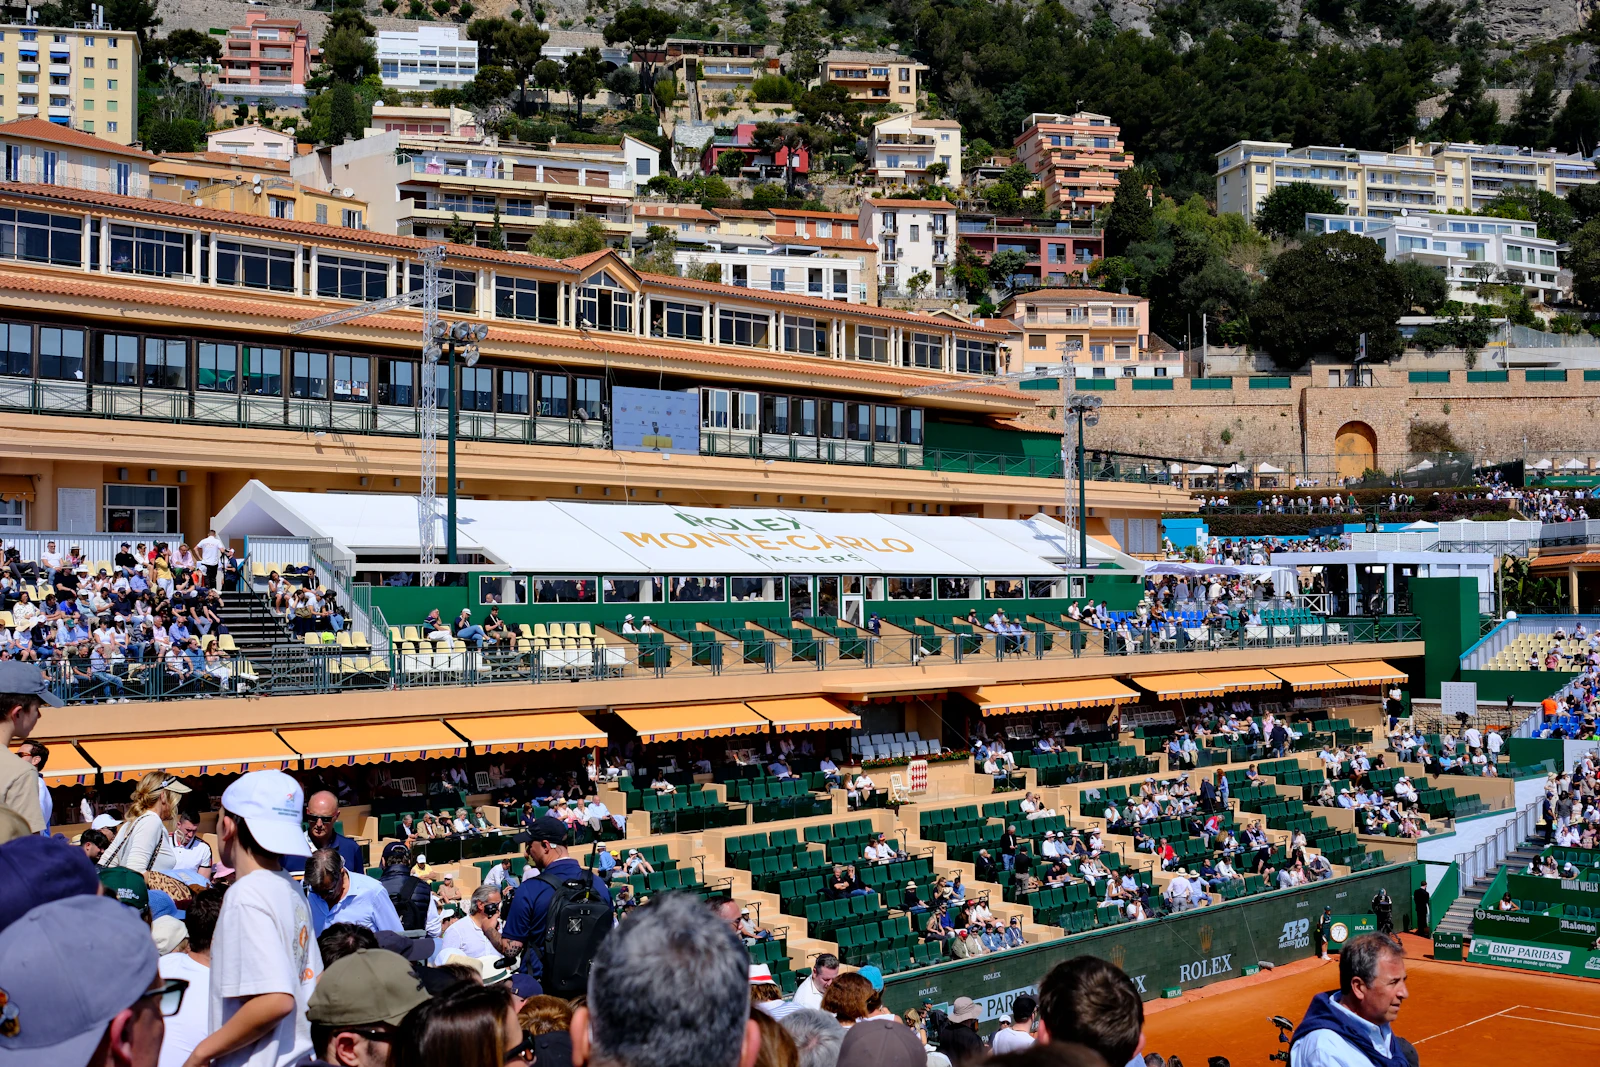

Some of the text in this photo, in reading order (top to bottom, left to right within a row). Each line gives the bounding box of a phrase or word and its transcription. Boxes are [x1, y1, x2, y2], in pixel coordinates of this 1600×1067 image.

[674, 512, 814, 532] ROLEX
[620, 531, 915, 553] MONTE-CARLO
[747, 553, 863, 564] MASTERS
[1561, 879, 1599, 893] INDIAN WELLS
[1335, 891, 1348, 899] ROLEX
[1296, 900, 1310, 908] ROLEX
[1486, 912, 1530, 924] Sergio Tacchini
[1560, 919, 1596, 933] Malongo
[1278, 935, 1310, 949] MASTERS 1000
[1492, 944, 1564, 962] BNP PARIBAS
[1179, 953, 1233, 983] ROLEX
[1245, 967, 1260, 976] REPLAY
[983, 971, 1001, 981] ROLEX
[918, 986, 938, 996] ROLEX
[1167, 988, 1182, 998] REPLAY
